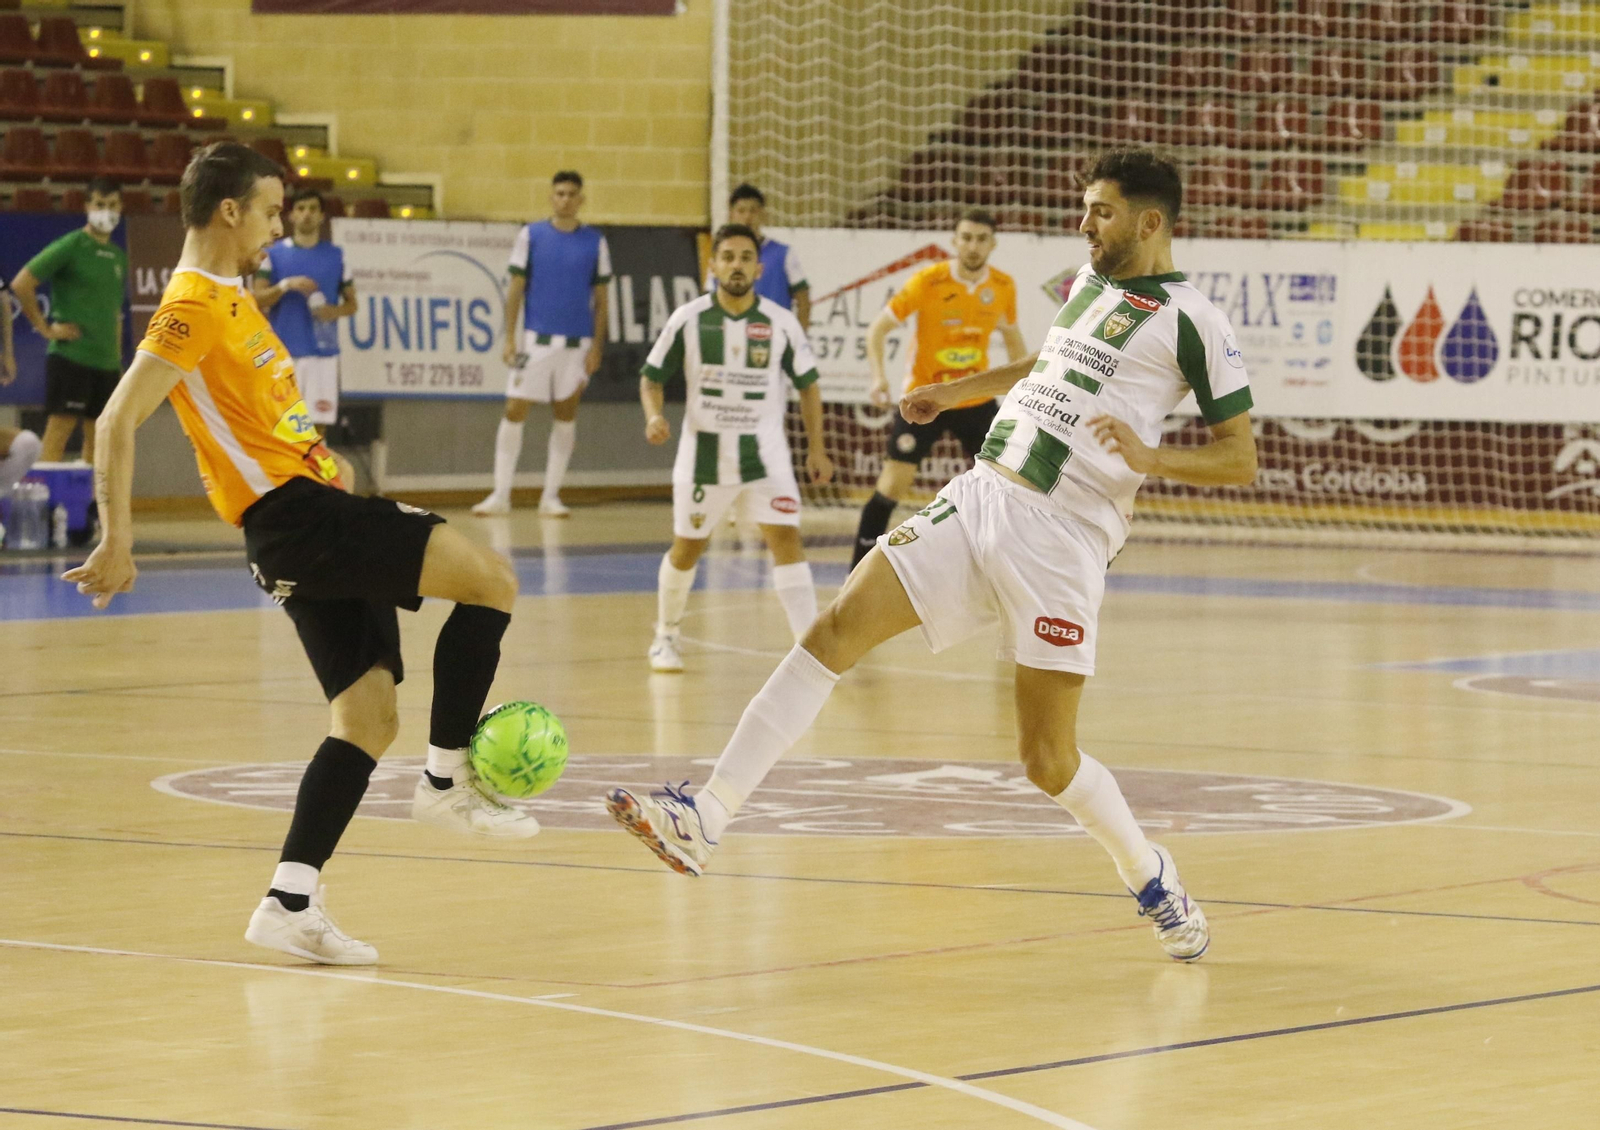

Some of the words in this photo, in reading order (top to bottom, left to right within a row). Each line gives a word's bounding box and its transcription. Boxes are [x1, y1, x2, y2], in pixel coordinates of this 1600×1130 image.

[1514, 287, 1600, 309] COMER
[350, 296, 495, 353] UNIFIS
[807, 335, 845, 360] 37
[855, 336, 901, 361] 57
[1063, 337, 1113, 364] PATRIMONIO
[1057, 346, 1115, 378] HUMANIDAD
[1506, 366, 1600, 387] PINTU
[1018, 394, 1081, 428] Catedral
[1043, 418, 1074, 438] Córdoba
[1038, 620, 1080, 641] Deza
